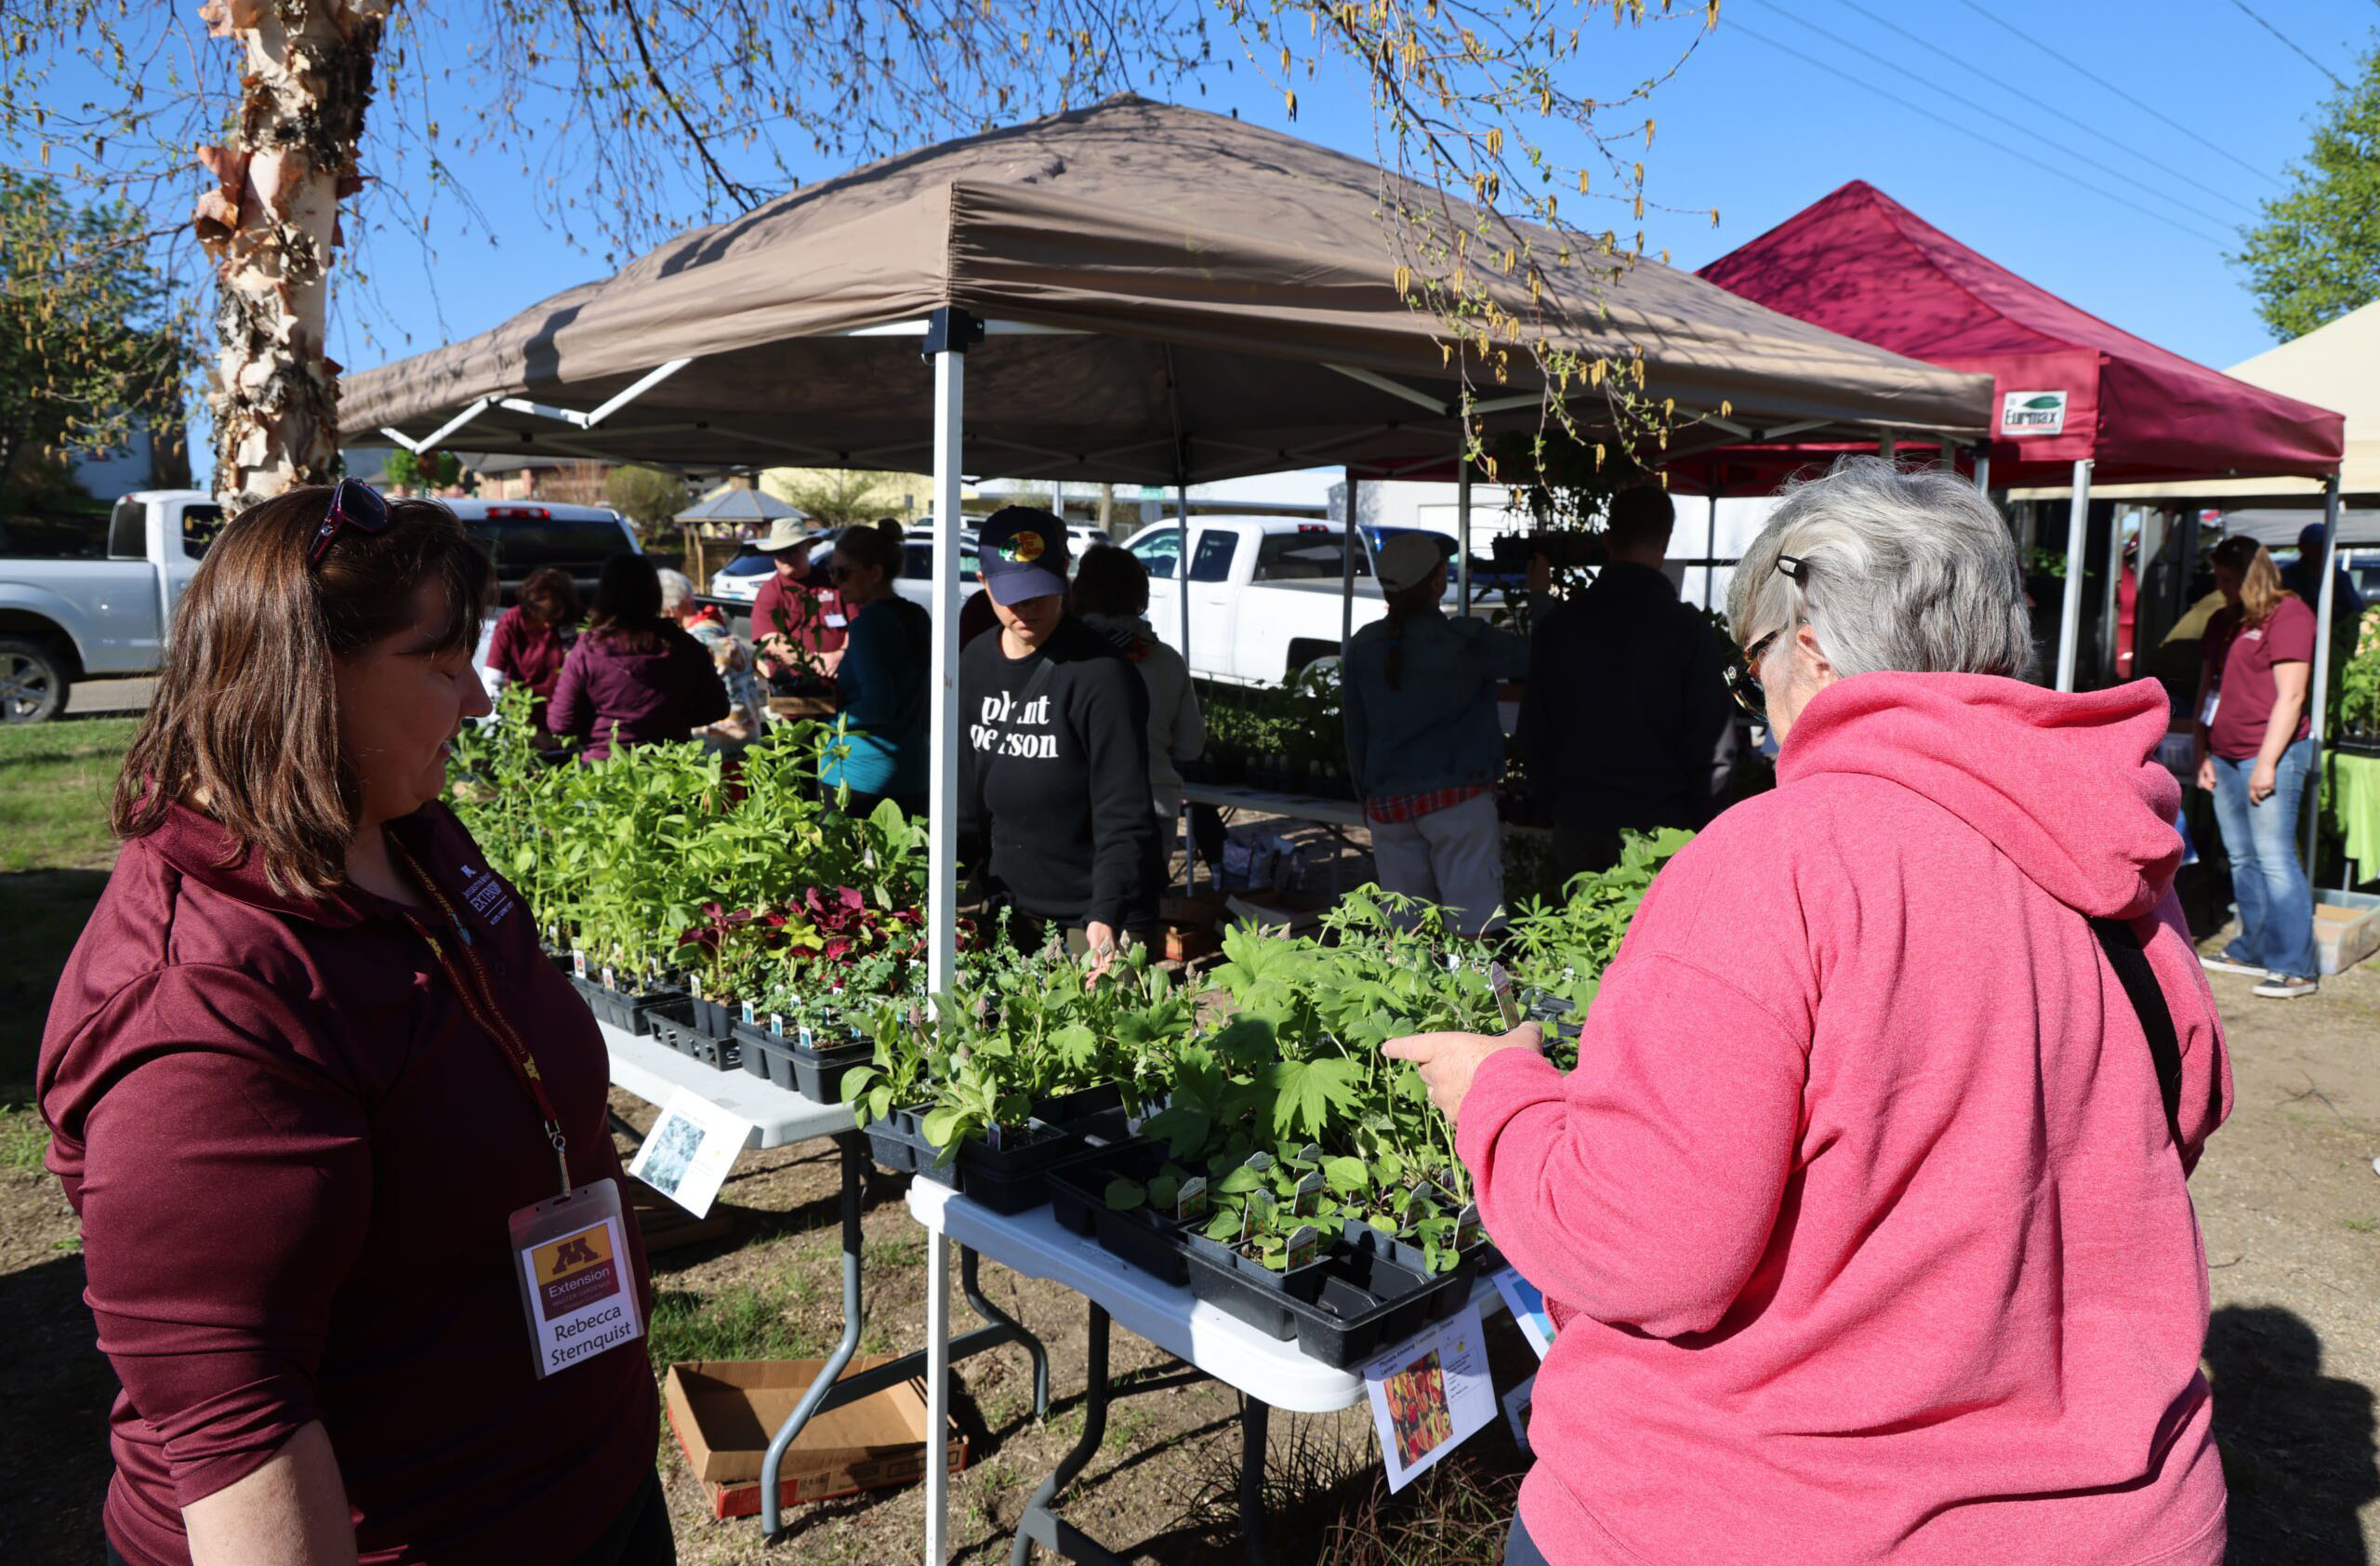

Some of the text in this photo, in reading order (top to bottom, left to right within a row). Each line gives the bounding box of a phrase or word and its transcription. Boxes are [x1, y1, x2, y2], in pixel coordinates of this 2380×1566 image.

[2005, 409, 2057, 424] Eurmax
[549, 1267, 610, 1298] Extension
[554, 1306, 622, 1342] Rebecca
[551, 1321, 632, 1366] Sternquist
